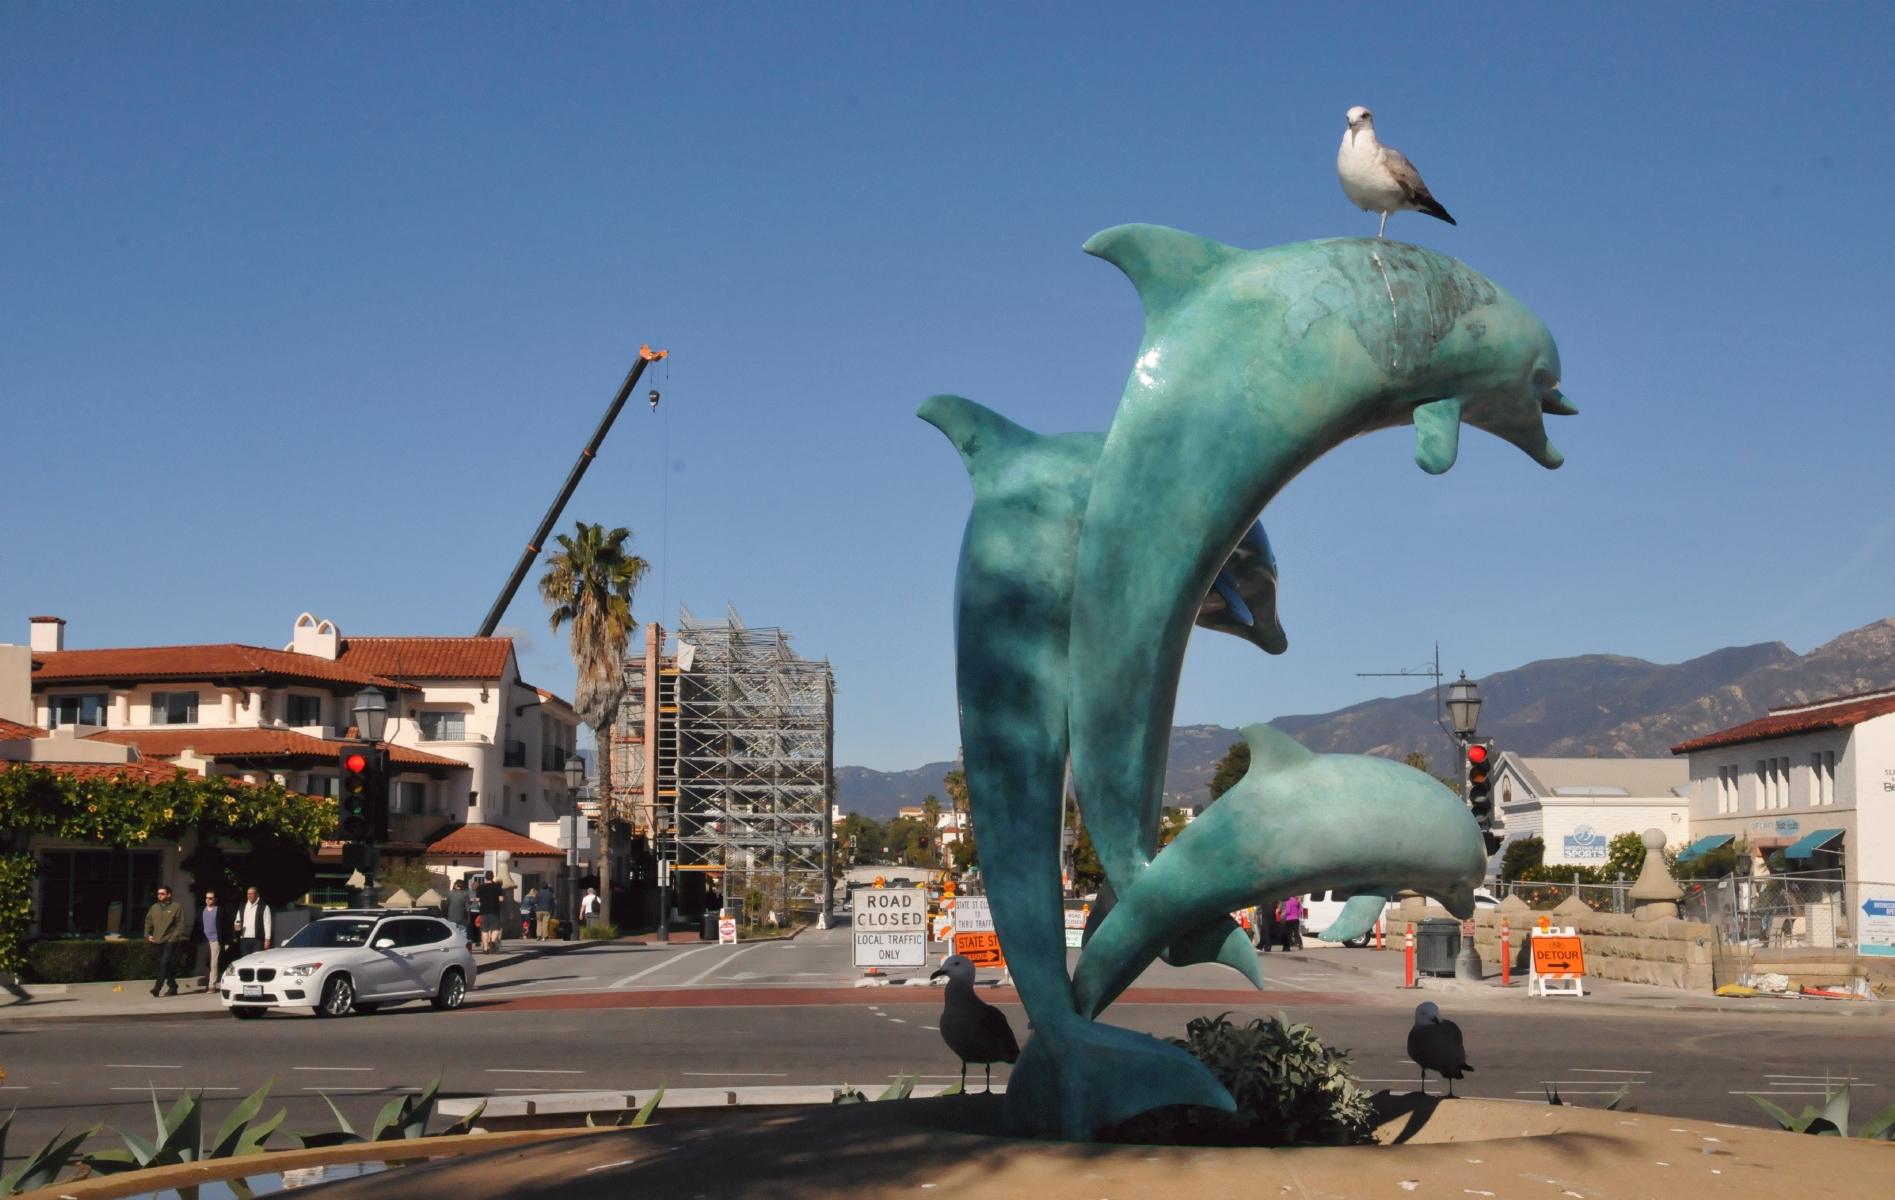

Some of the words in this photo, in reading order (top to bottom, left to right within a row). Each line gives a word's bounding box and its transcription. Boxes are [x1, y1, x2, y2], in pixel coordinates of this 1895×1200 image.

[1564, 850, 1605, 858] SPORTS
[867, 895, 912, 908] ROAD
[956, 900, 970, 909] STATE
[972, 900, 978, 909] ST
[857, 912, 922, 926] CLOSED
[974, 910, 981, 918] TO
[958, 920, 974, 929] THRU
[857, 934, 884, 945] LOCAL
[888, 934, 922, 945] TRAFFIC
[958, 936, 984, 949] STATE
[988, 935, 998, 947] ST
[878, 949, 901, 960] ONLY
[1537, 950, 1579, 960] DETOUR
